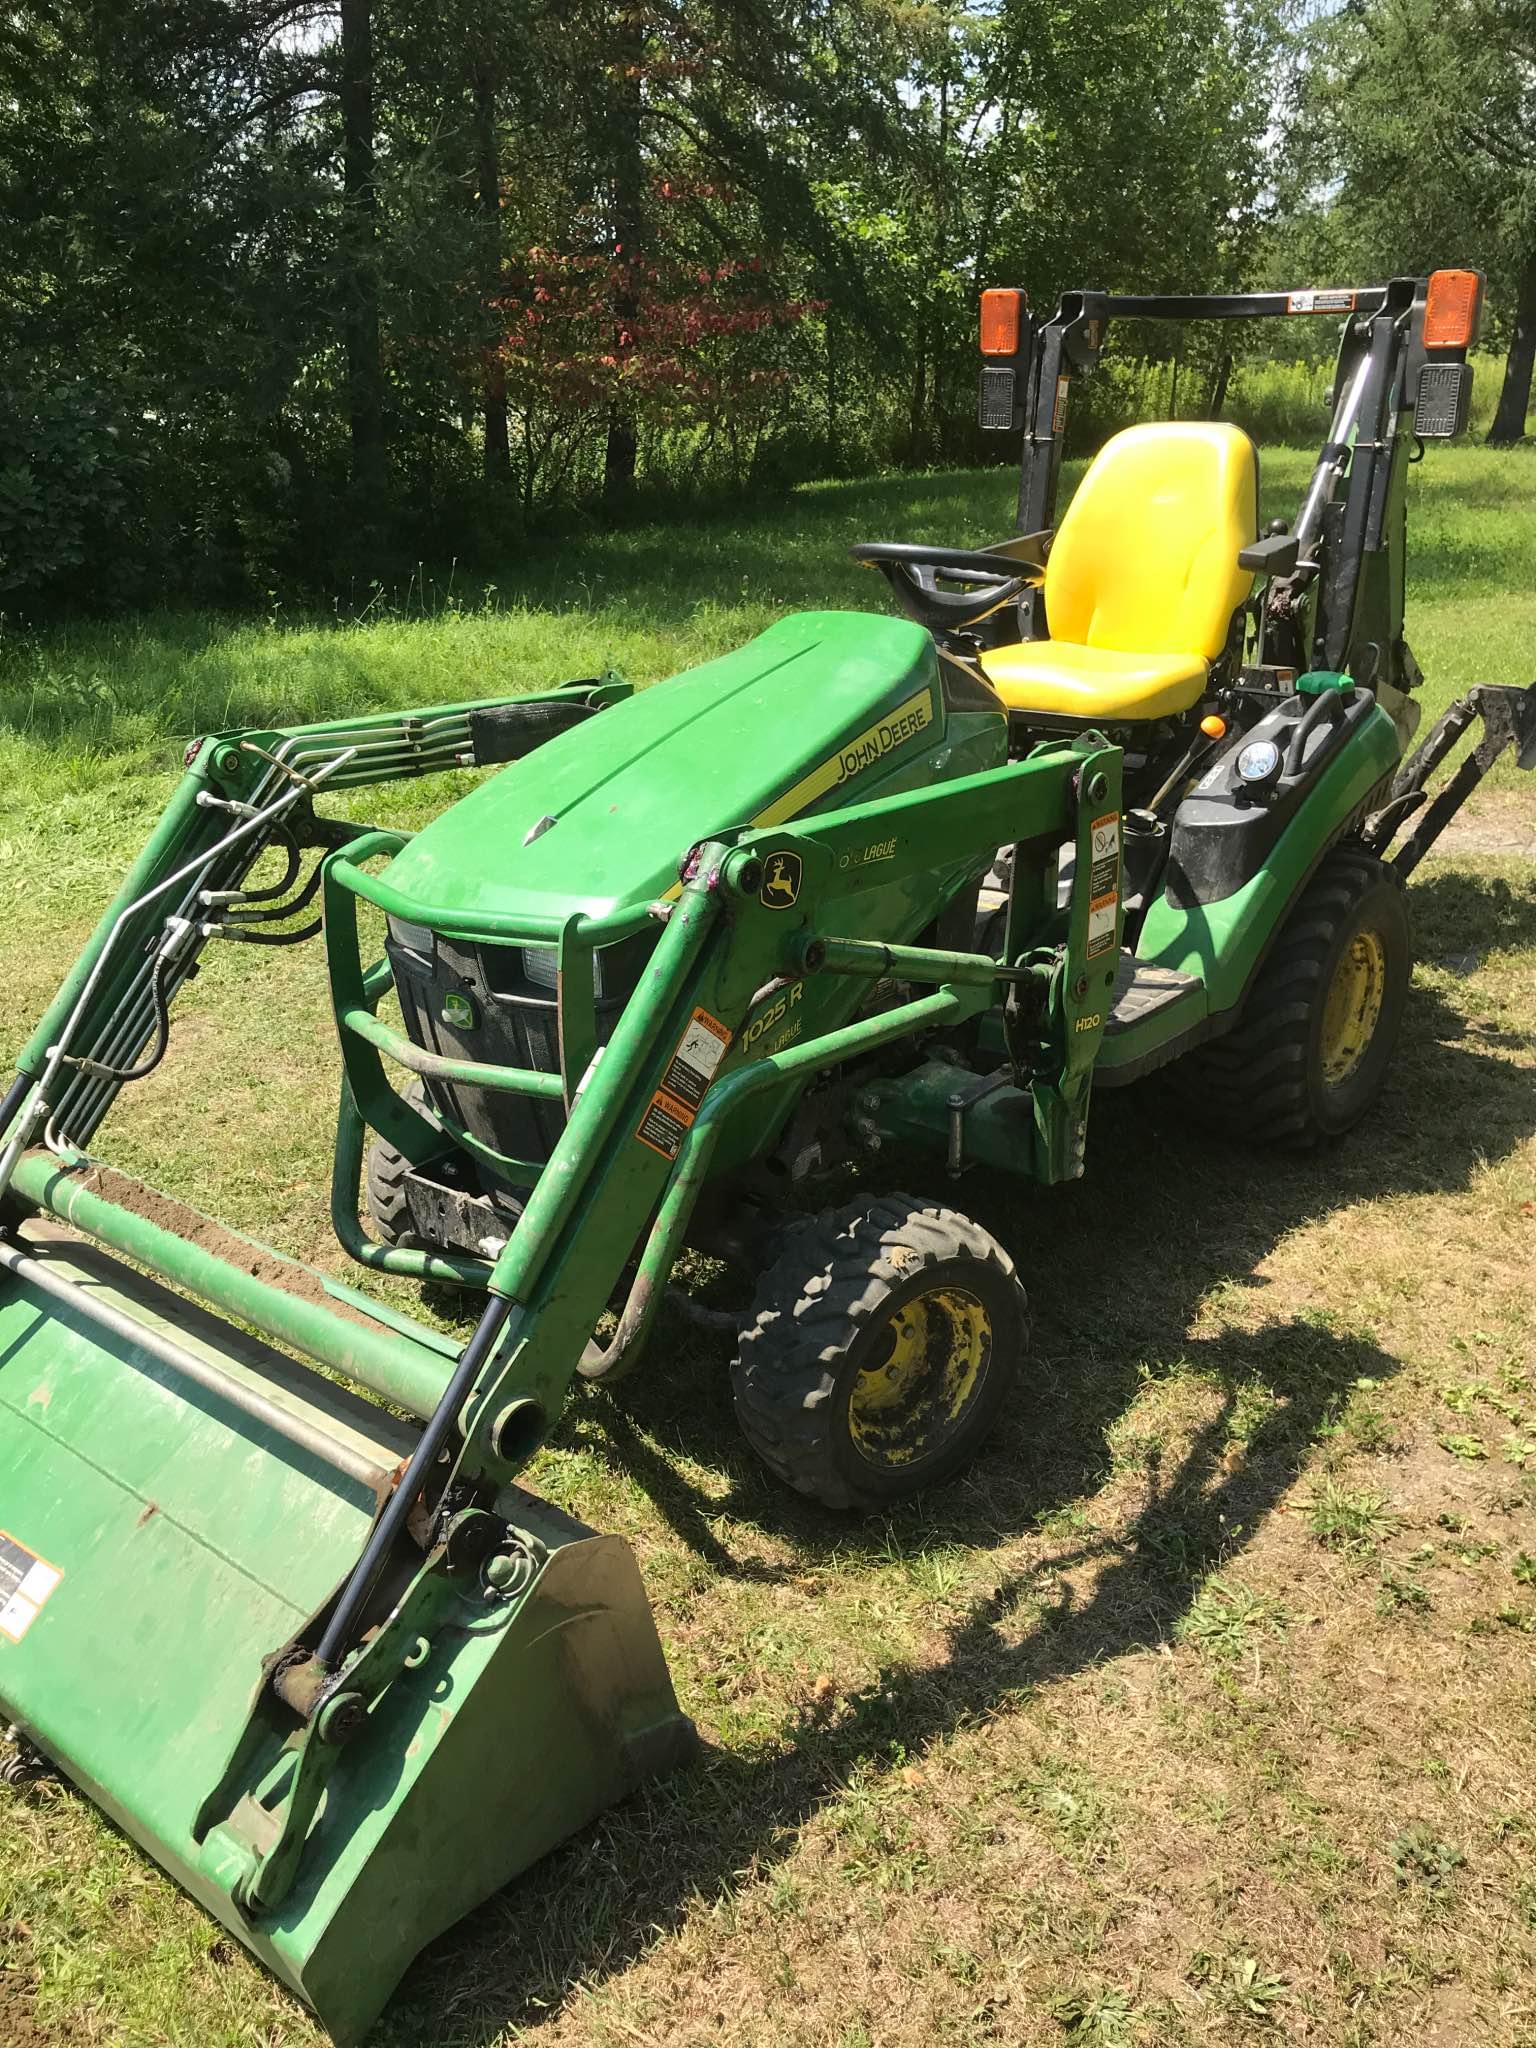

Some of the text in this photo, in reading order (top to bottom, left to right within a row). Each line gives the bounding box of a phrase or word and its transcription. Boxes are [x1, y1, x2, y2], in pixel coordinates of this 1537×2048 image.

[838, 707, 926, 782] JOHN DEERE
[742, 982, 803, 1053] 1025 R
